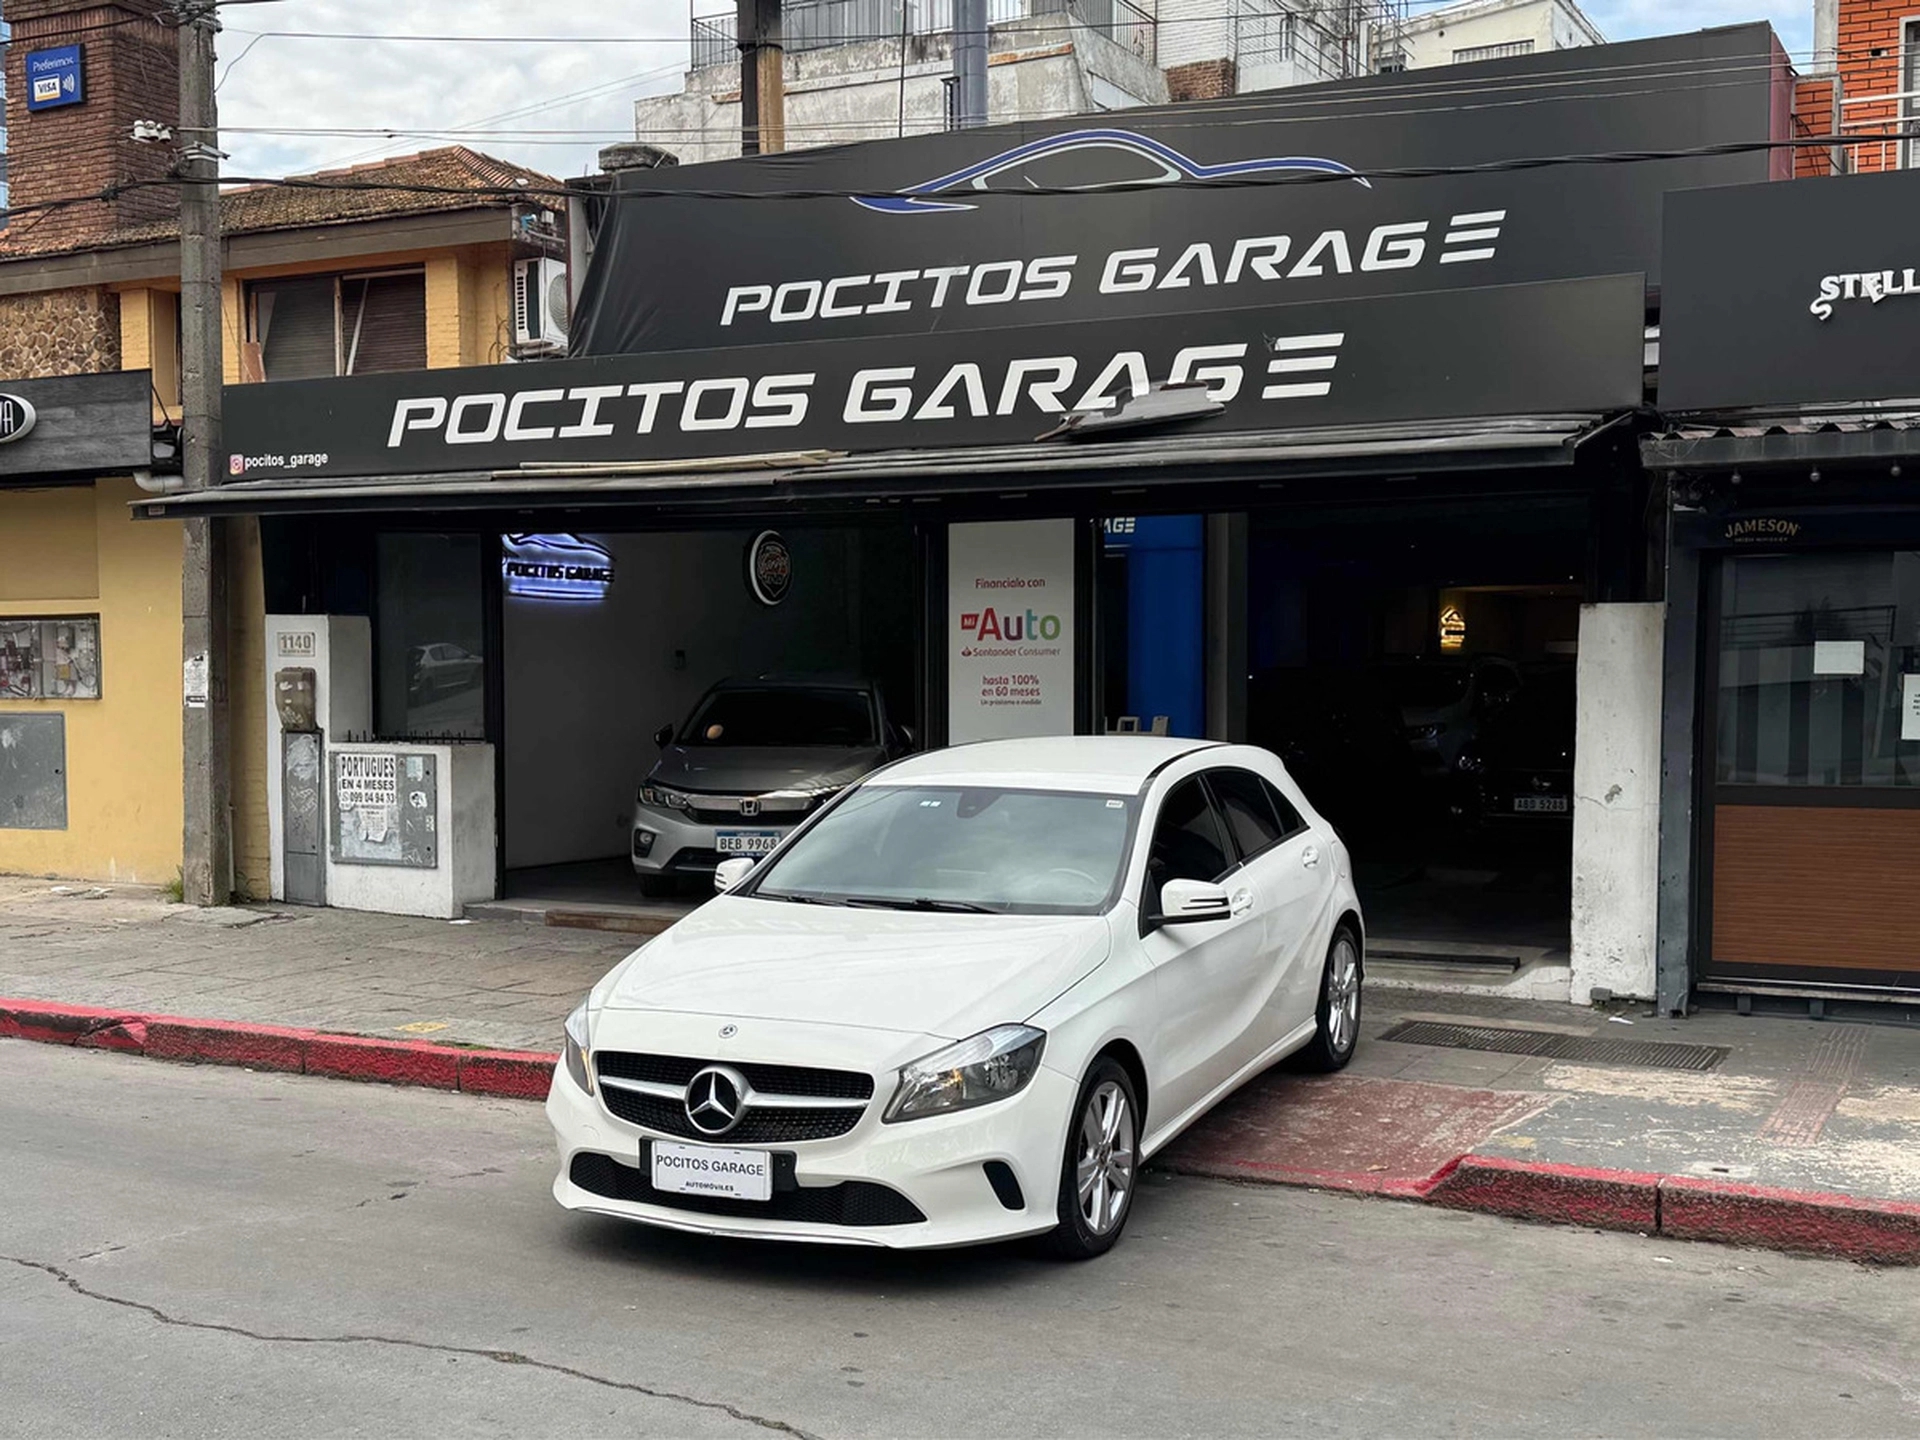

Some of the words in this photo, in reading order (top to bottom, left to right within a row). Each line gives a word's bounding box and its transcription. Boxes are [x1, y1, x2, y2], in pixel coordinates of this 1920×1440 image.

[38, 82, 57, 93] VISA
[720, 255, 1078, 326] POCITOS
[1099, 210, 1506, 294] GARAGE
[387, 372, 816, 448] POCITOS
[842, 333, 1345, 424] GARAGE
[245, 453, 328, 471] pocitos_garage
[1725, 519, 1799, 538] JAMESON
[1027, 579, 1046, 588] con
[977, 607, 1061, 641] Auto
[281, 635, 311, 649] 1140
[973, 647, 1016, 657] Santander
[1018, 647, 1061, 657] Consumer
[983, 675, 1009, 685] hasta
[1012, 674, 1039, 685] 100%
[982, 688, 994, 697] en
[995, 686, 1008, 697] 60
[1010, 687, 1040, 697] meses
[341, 756, 395, 777] PORTUGUES
[342, 779, 354, 789] EN
[356, 780, 362, 789] 4
[364, 780, 394, 790] MESES
[720, 838, 742, 850] BEB
[747, 838, 777, 850] 9968
[656, 1155, 709, 1171] POCITOS
[711, 1160, 764, 1176] GARAGE
